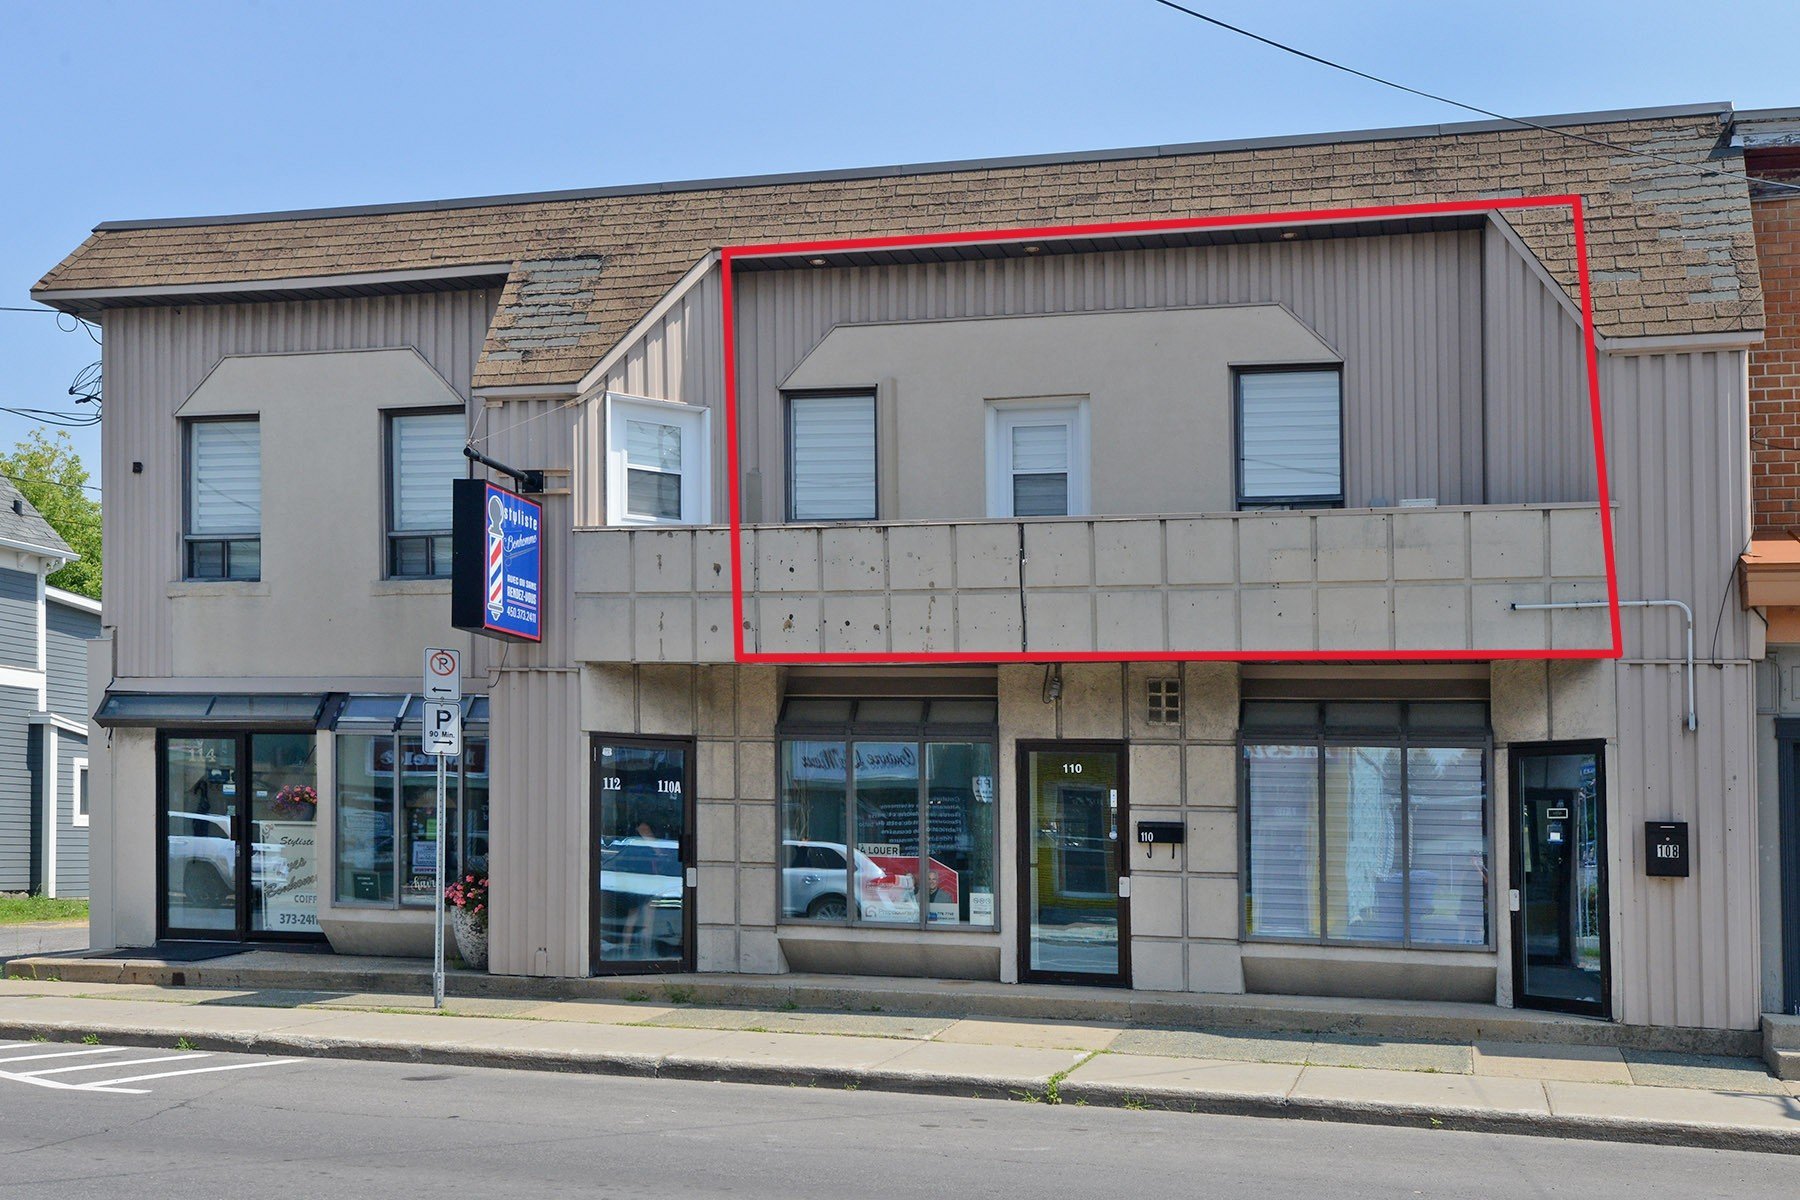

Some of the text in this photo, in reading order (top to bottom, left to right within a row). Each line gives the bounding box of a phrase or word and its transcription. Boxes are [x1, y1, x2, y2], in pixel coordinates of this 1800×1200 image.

[507, 585, 537, 605] RENDEZ-VOUS
[436, 709, 451, 729] P
[189, 748, 216, 762] 114
[1062, 763, 1083, 774] 110
[603, 777, 621, 790] 112
[657, 780, 682, 793] 110A
[280, 836, 314, 847] Styliste
[1141, 831, 1154, 842] 110
[869, 846, 899, 855] LOUER
[1657, 844, 1680, 859] 108
